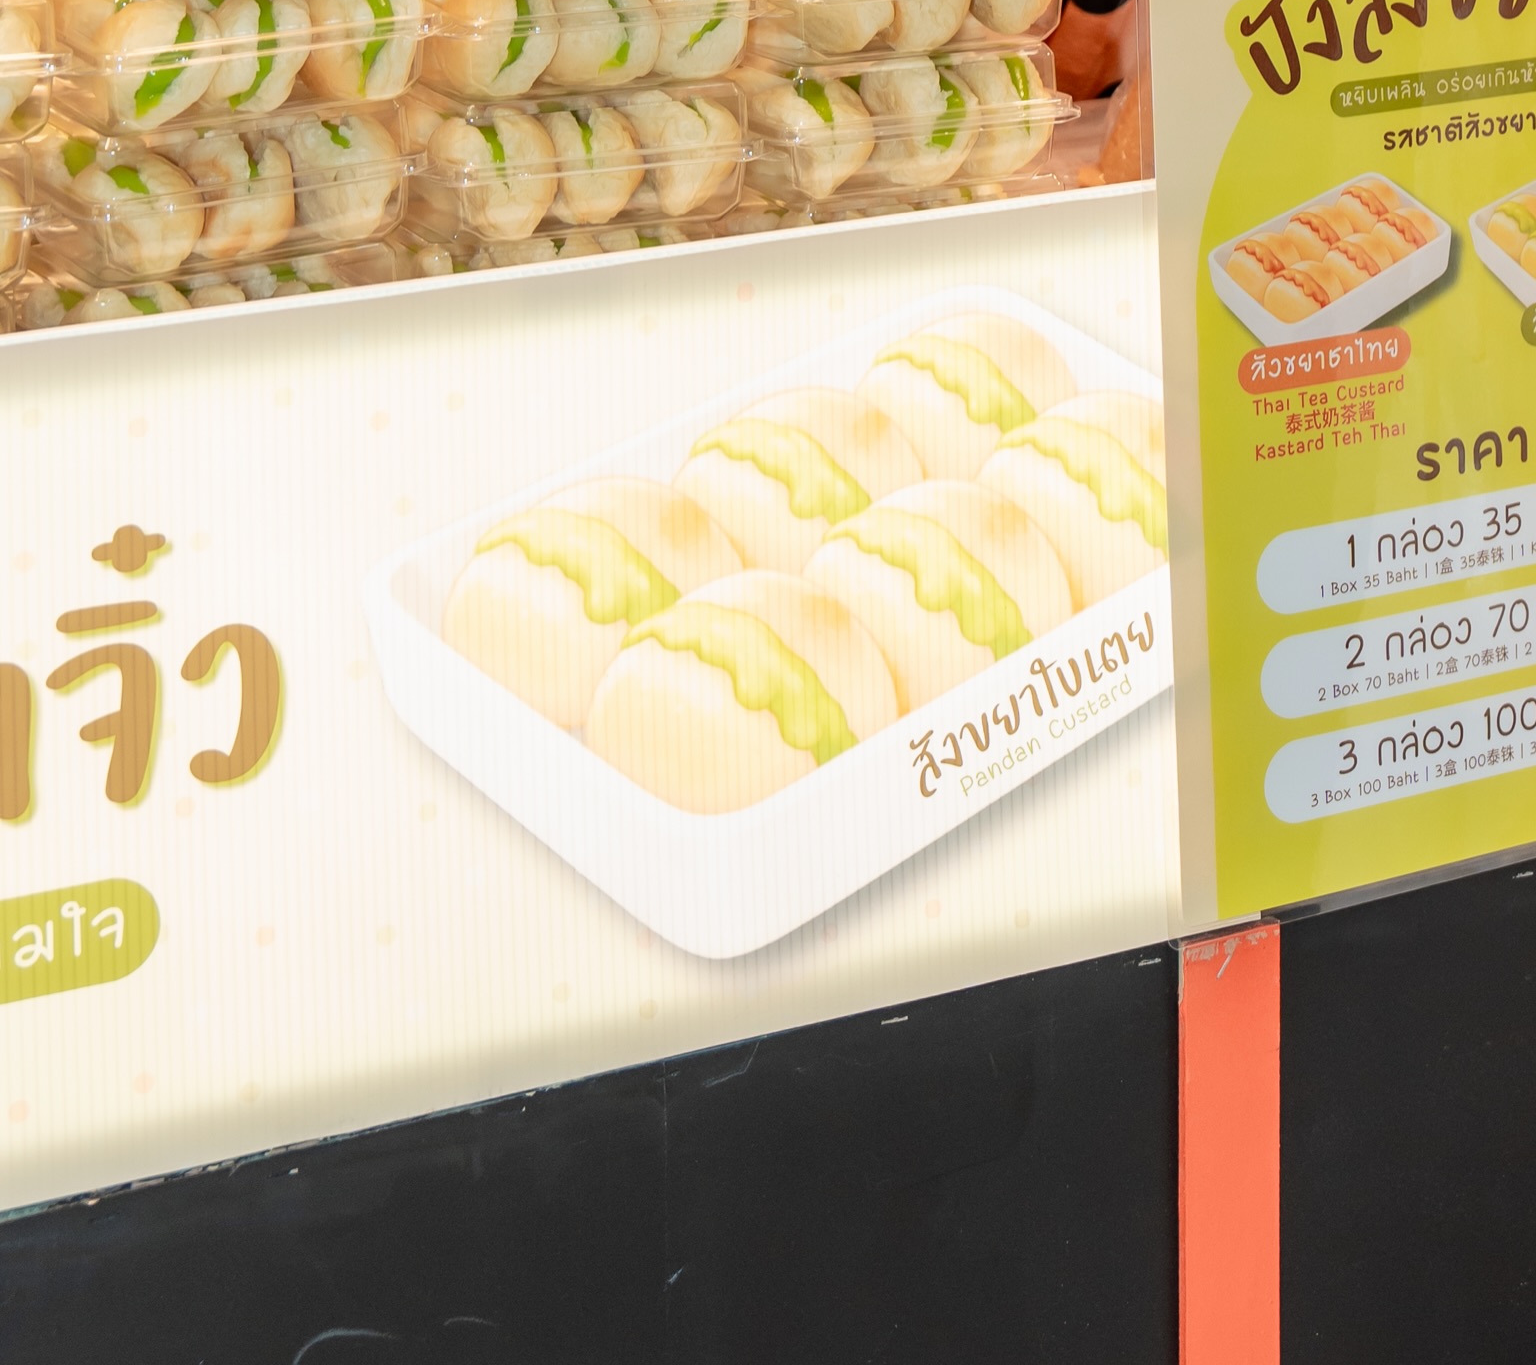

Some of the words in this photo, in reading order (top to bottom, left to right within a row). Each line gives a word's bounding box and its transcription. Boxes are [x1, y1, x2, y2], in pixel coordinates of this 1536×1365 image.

[1339, 79, 1426, 108] หยิบเพลิน
[1252, 397, 1290, 416] Thai
[1298, 391, 1328, 409] Tea
[1336, 374, 1405, 401] Custard
[1285, 400, 1376, 435] 泰式奶茶酱
[1255, 434, 1324, 462] Kastard
[1332, 428, 1362, 447] Teh
[1370, 422, 1406, 441] Thai
[1416, 425, 1529, 482] ราคา
[1347, 534, 1355, 568] 1
[1377, 517, 1464, 563] กล่อง
[1482, 501, 1522, 542] 35
[1320, 585, 1325, 598] 1
[1331, 580, 1358, 596] Box
[1364, 575, 1380, 590] 35
[1386, 567, 1418, 585] Baht
[1520, 544, 1525, 556] 1
[1345, 634, 1366, 670] 2
[1385, 615, 1472, 661] กล่อง
[1488, 598, 1530, 638] 70
[1318, 687, 1327, 702] 2
[1333, 682, 1360, 698] Box
[1365, 675, 1382, 691] 70
[1388, 668, 1420, 686] Baht
[1524, 642, 1533, 656] 2
[909, 611, 1154, 798] สังขยาใบเตย
[959, 736, 1042, 797] Pandan
[1048, 673, 1133, 739] Custard
[1338, 739, 1358, 775] 3
[1378, 719, 1464, 766] กล่อง
[1311, 793, 1319, 808] 3
[1325, 788, 1351, 805] Box
[1358, 779, 1381, 796] 100
[1387, 771, 1419, 789] Baht
